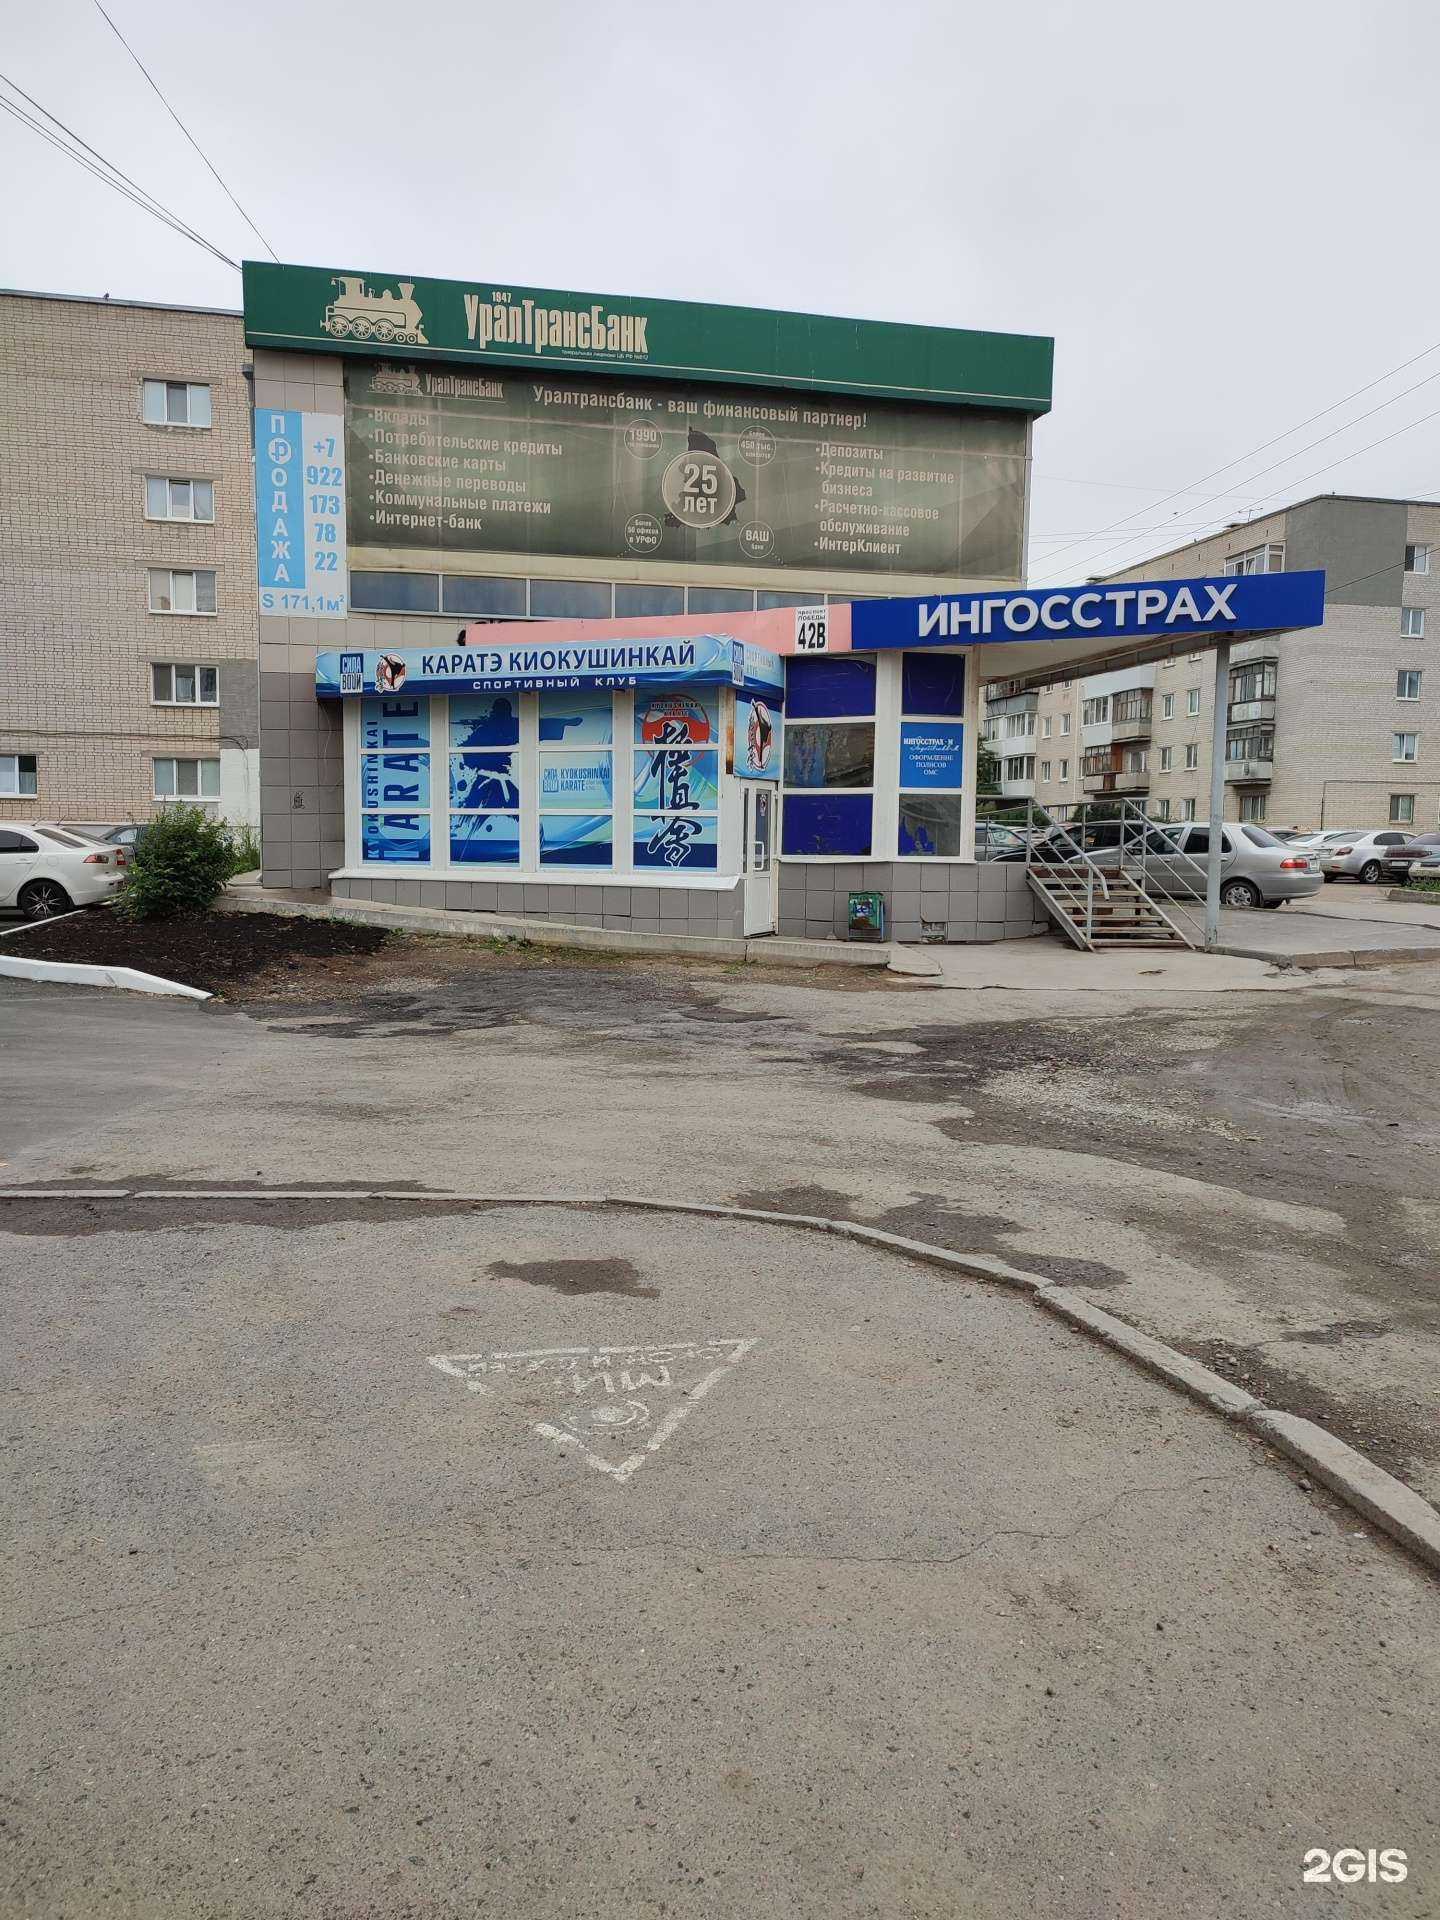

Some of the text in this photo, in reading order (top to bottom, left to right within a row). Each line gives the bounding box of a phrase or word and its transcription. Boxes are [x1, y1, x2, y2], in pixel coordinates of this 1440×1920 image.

[464, 294, 649, 354] УралТрансБанк
[533, 385, 652, 411] Уралтрансбанк
[667, 400, 698, 415] ваш
[703, 400, 799, 423] финансовый
[803, 411, 867, 431] партнер!
[313, 438, 335, 458] +7
[374, 428, 562, 456] Потребительские кредиты
[820, 442, 884, 461] Депозиты
[374, 448, 506, 473] Банковские карты
[307, 465, 342, 486] 922
[374, 469, 527, 493] Денежные переводы
[683, 464, 718, 495] 25
[820, 461, 955, 484] Кредиты на развитие
[267, 414, 291, 583] ПРОДАЖА
[822, 480, 873, 497] бизнеса
[309, 494, 340, 514] 173
[374, 490, 552, 515] Коммунальные платежи
[683, 496, 718, 514] лет
[375, 510, 483, 531] Интернет-банк
[820, 518, 910, 537] обслуживание
[314, 523, 337, 543] 78
[745, 529, 770, 542] ВАШ
[819, 536, 902, 555] ИнтерКлиент
[314, 551, 338, 571] 22
[262, 593, 274, 608] S
[917, 583, 1238, 637] ИНГОССТРАХ
[422, 639, 695, 674] КАРАТЭ КИОКУШИНКАЙ
[473, 676, 637, 690] СПОРТИВНЫЙ КЛУБ
[382, 701, 420, 861] KARATE
